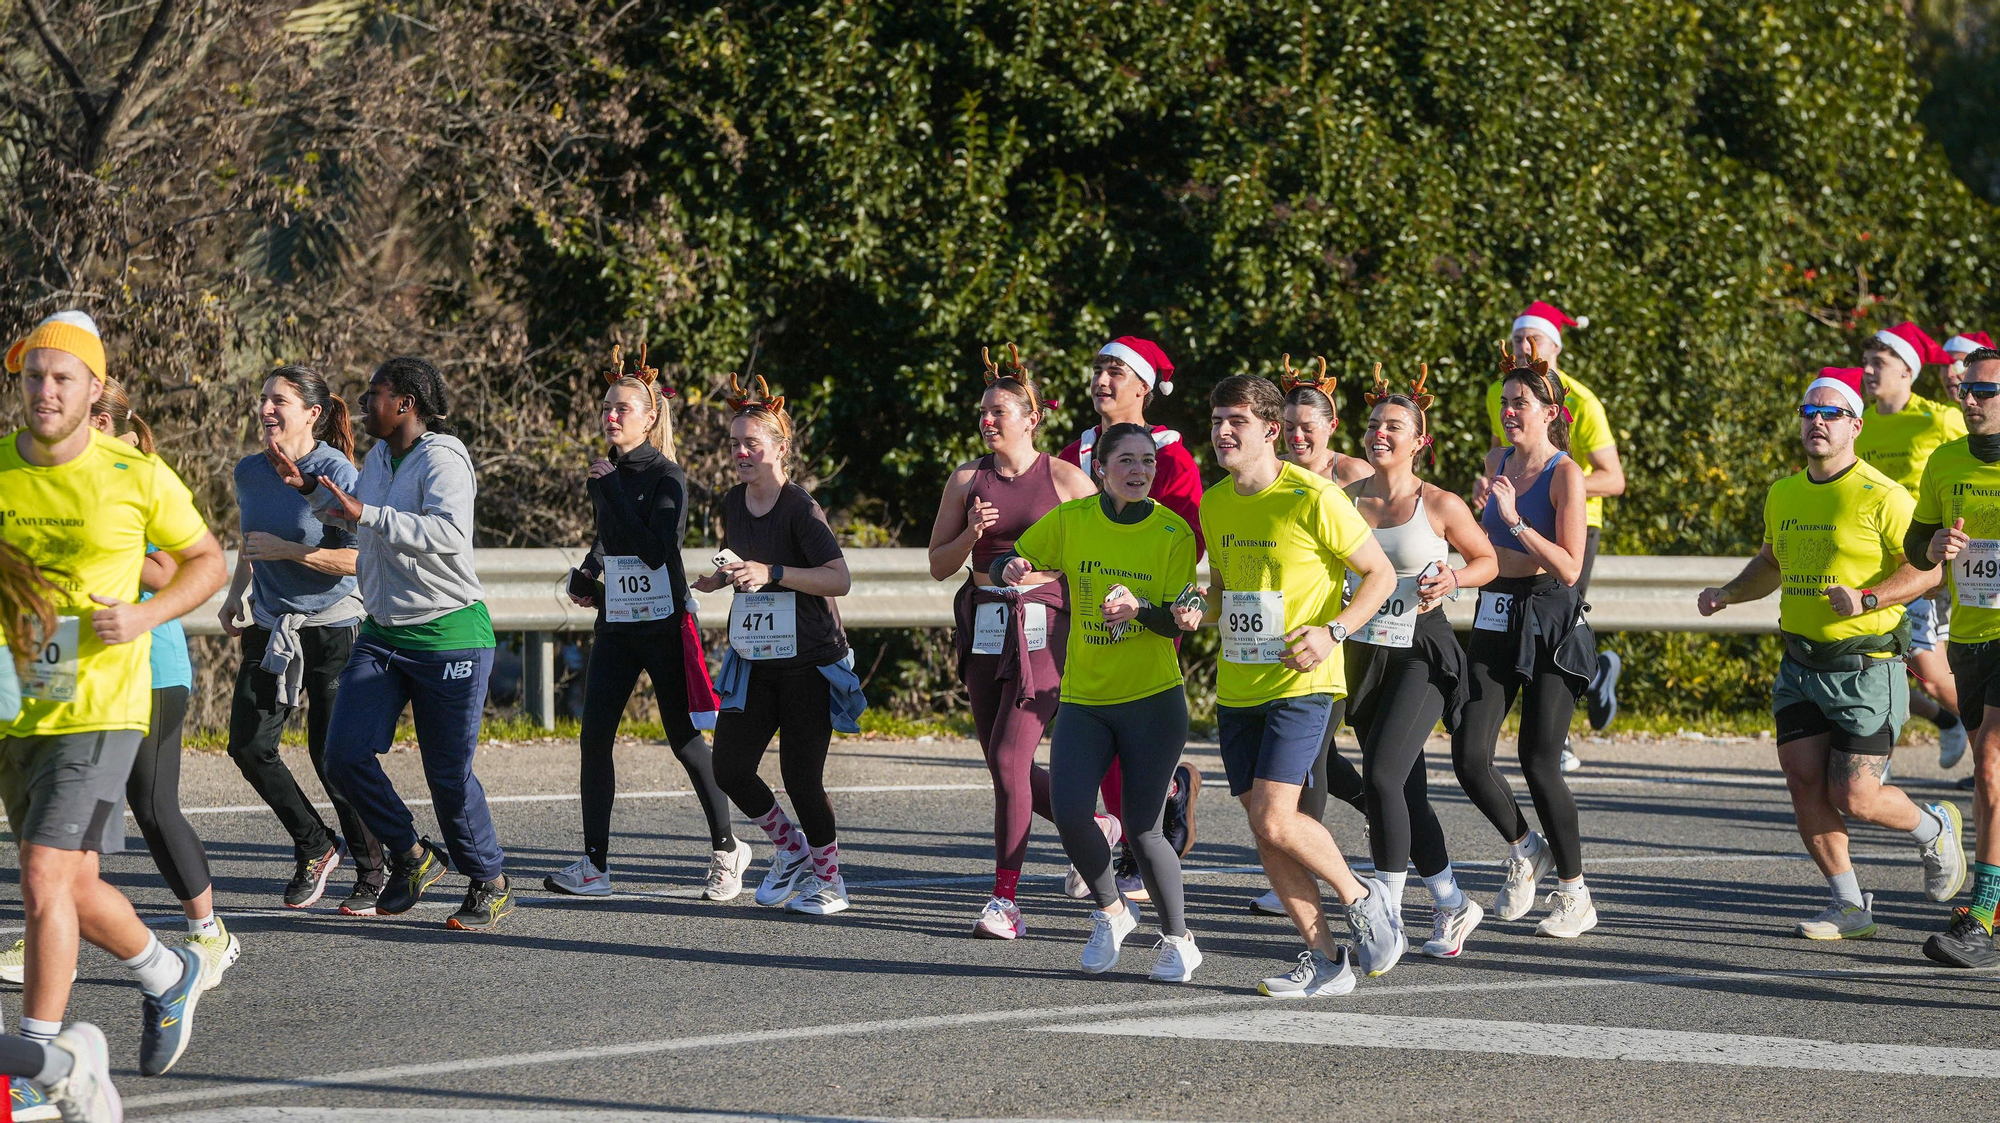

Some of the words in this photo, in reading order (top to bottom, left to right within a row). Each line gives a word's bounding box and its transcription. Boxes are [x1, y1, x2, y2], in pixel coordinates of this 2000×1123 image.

[1951, 483, 1972, 496] 41º
[15, 517, 85, 528] ANIVERSARIO
[1796, 524, 1837, 532] ANIVERSARIO
[1234, 540, 1277, 548] ANIVERSARIO
[1078, 560, 1101, 574] 41º
[1099, 568, 1153, 582] ANIVERSARIO
[1962, 559, 2000, 579] 149
[618, 575, 652, 594] 103
[1789, 574, 1839, 584] SILVESTRE
[1784, 587, 1824, 597] ORDOBES
[742, 613, 774, 631] 471
[1229, 612, 1263, 633] 936
[443, 660, 473, 680] NB
